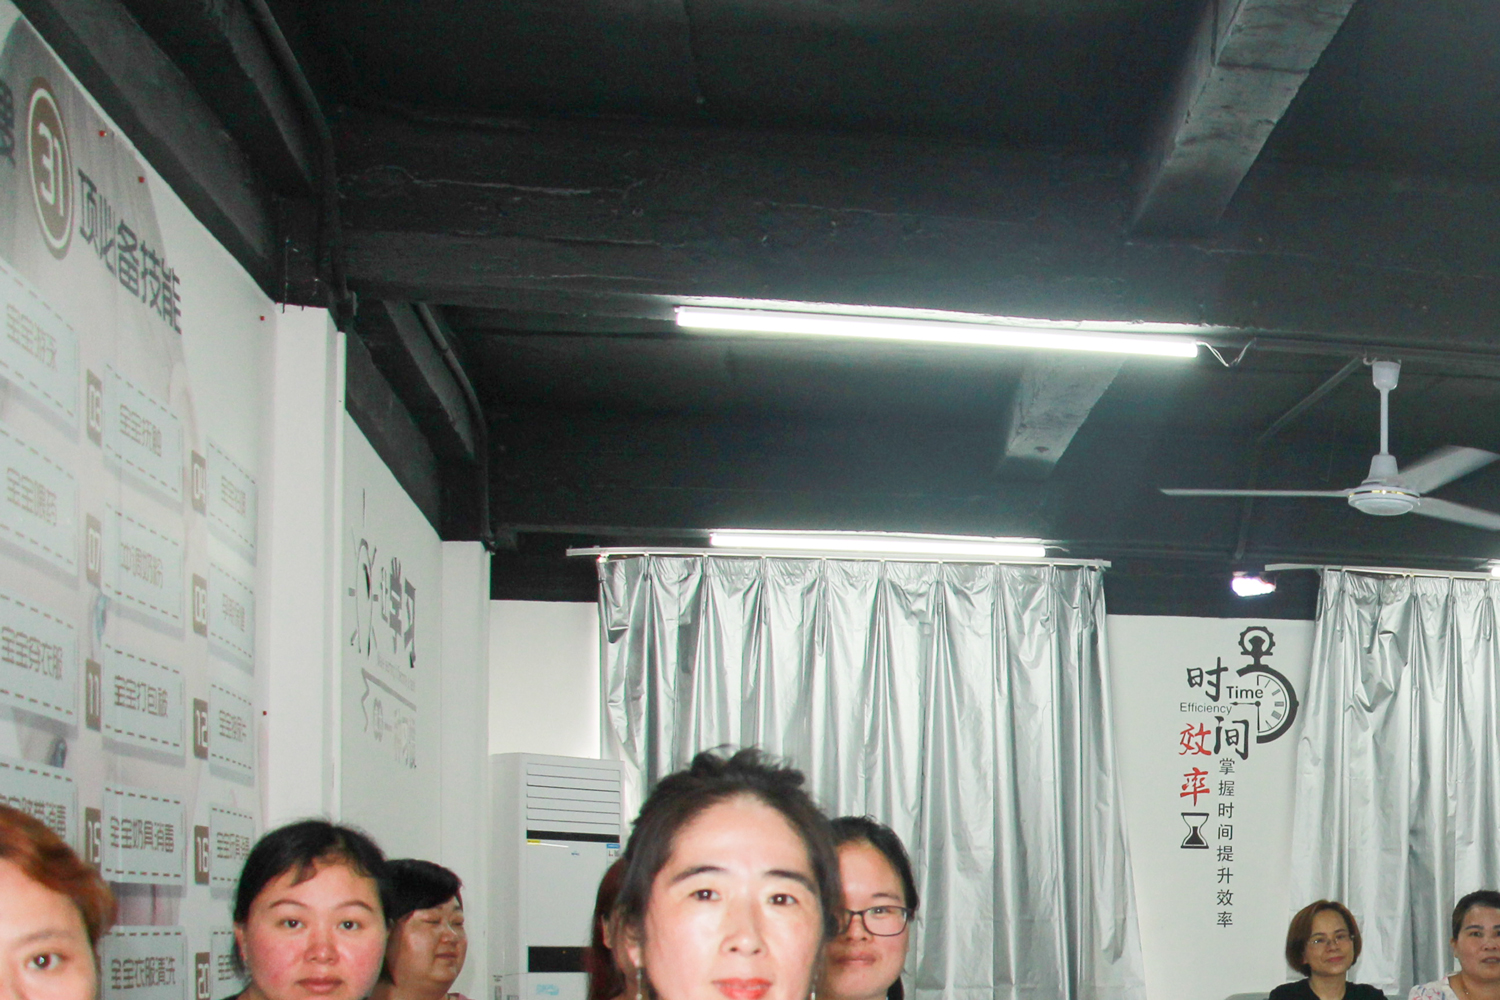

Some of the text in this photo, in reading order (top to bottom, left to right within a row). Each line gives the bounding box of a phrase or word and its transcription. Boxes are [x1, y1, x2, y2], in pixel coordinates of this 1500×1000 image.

[78, 168, 182, 334] 项必备技能
[1180, 701, 1233, 716] Efficiency
[1226, 685, 1264, 700] Time
[1179, 722, 1212, 807] 效率
[1216, 757, 1235, 928] 掌握时间提升效率
